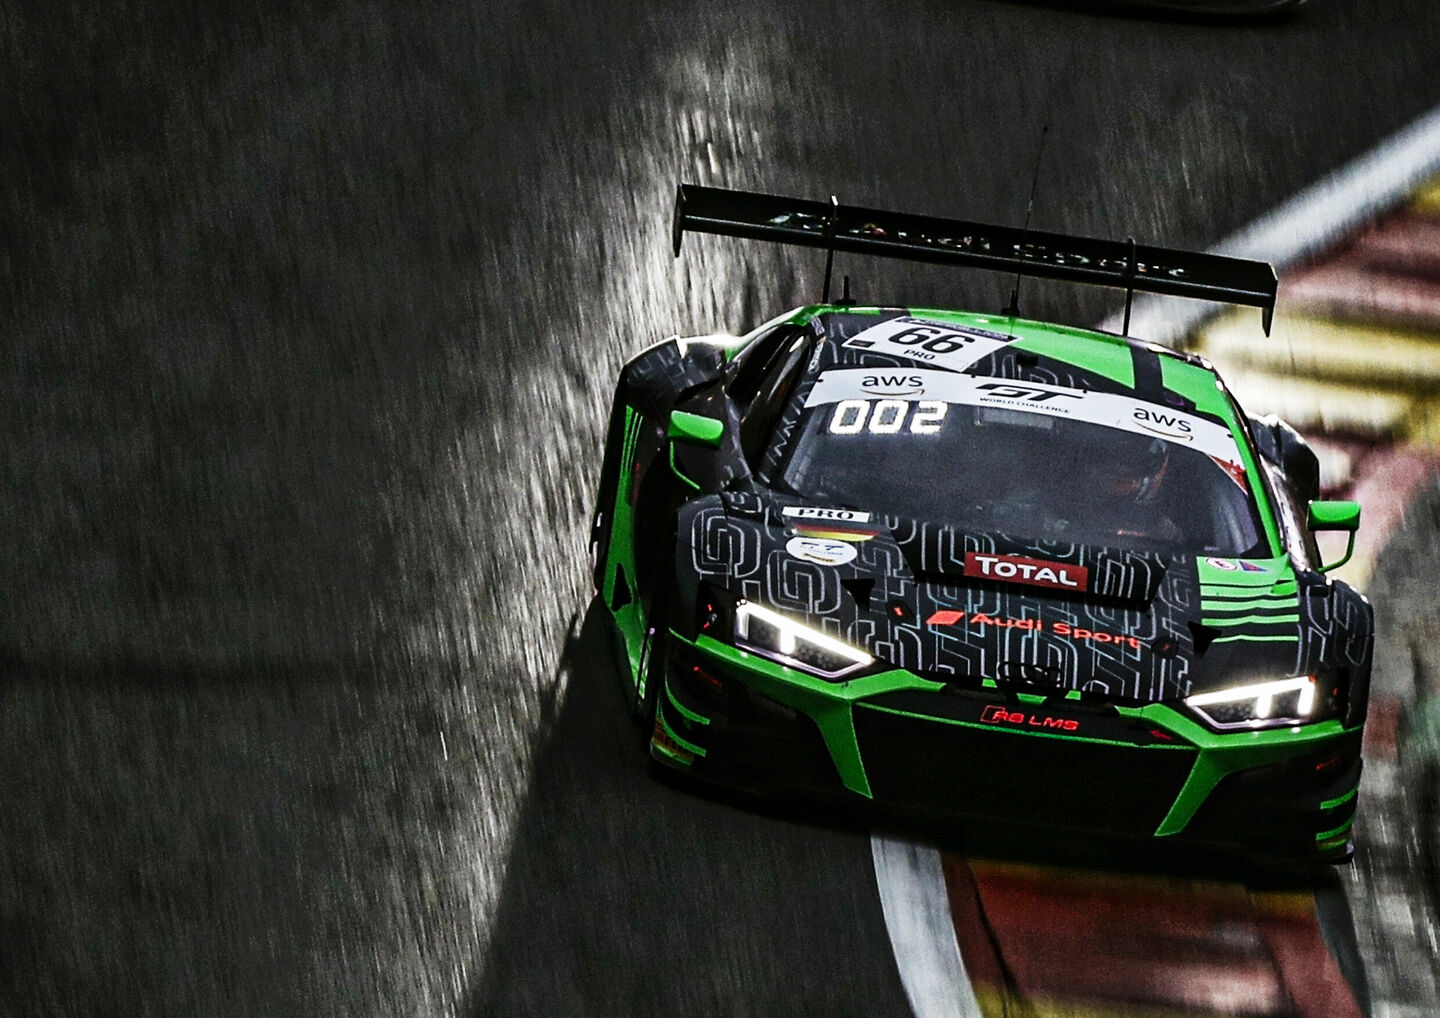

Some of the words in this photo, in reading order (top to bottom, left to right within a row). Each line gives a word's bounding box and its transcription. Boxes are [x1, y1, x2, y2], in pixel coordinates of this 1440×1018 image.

[888, 327, 975, 353] 66
[904, 349, 936, 361] PRO
[862, 375, 924, 388] aws
[975, 384, 1085, 402] GT
[980, 397, 1015, 405] WORLD
[1016, 402, 1070, 414] CHALLENGE
[829, 400, 949, 435] 002
[1133, 407, 1192, 433] aws
[798, 508, 854, 520] PRO
[975, 556, 1078, 587] TOTAL
[969, 612, 1043, 631] Audi
[1052, 622, 1140, 649] Sport
[1028, 715, 1081, 731] LMS
